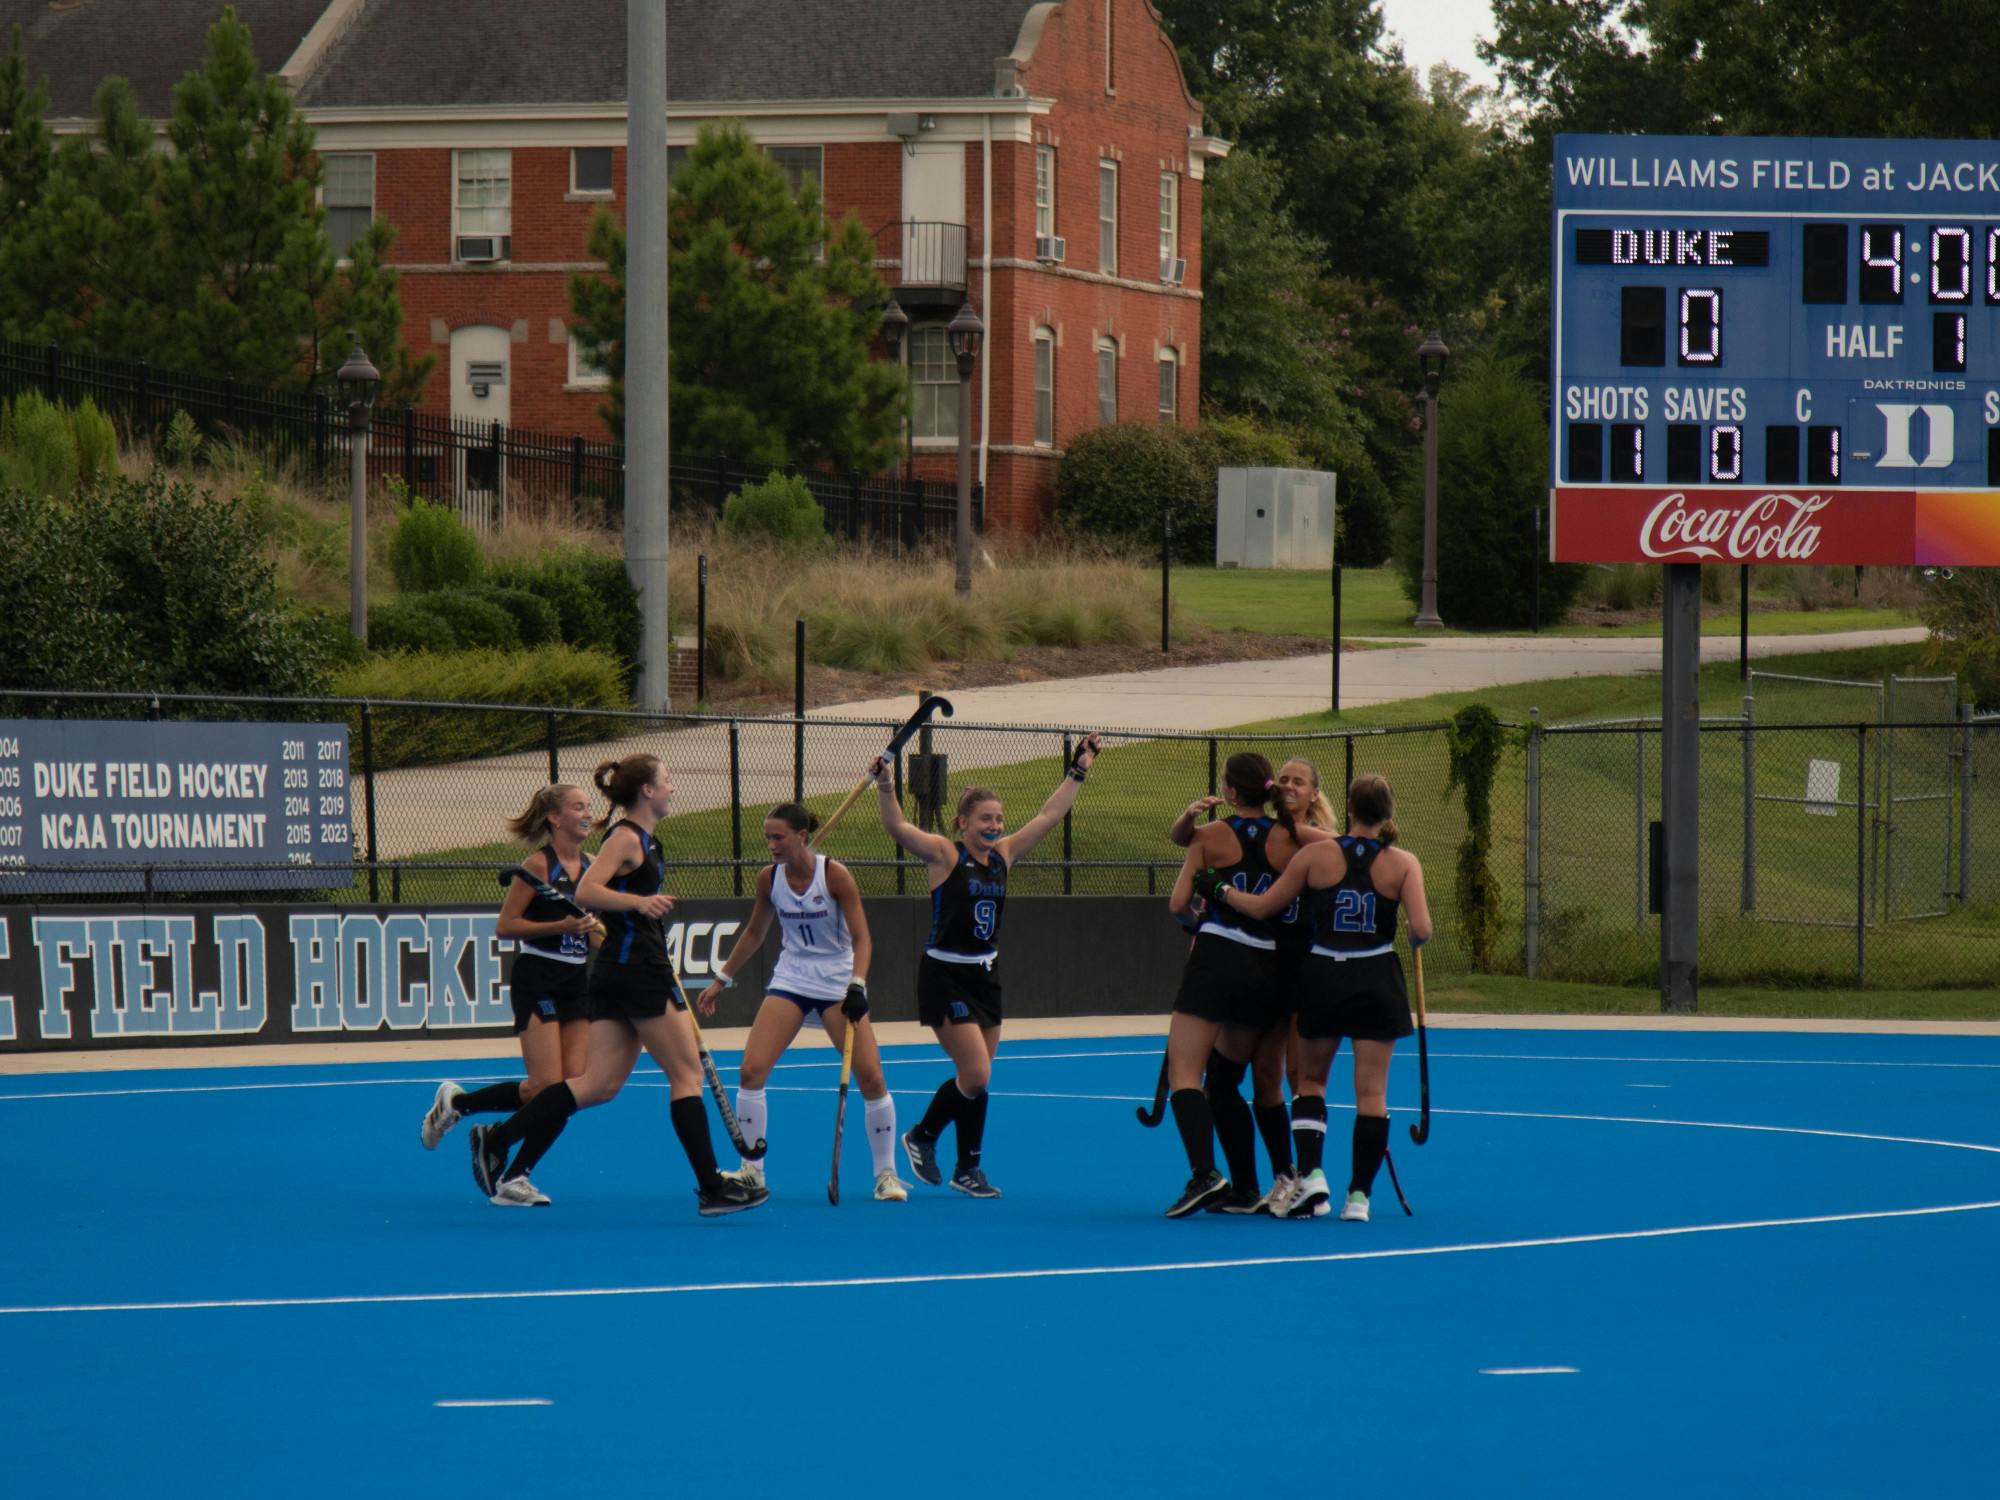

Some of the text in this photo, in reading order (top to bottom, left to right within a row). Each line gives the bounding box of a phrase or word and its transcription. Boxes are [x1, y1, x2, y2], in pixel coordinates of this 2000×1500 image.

[1567, 157, 2000, 192] WILLIAMS FIELD at JACK
[1612, 229, 1735, 265] DUKE
[1681, 289, 1719, 361] 0
[1826, 325, 1903, 358] HALF
[1956, 316, 1965, 365] 1
[1864, 380, 1966, 391] DAKTRONICS
[1567, 386, 1812, 422] SHOTS SAVES C
[1633, 427, 1643, 477] 1
[1712, 426, 1741, 480] 0
[1830, 429, 1840, 478] 1
[1639, 493, 1834, 560] Coca-Cola
[282, 741, 305, 761] 2011
[318, 741, 342, 761] 2017
[34, 762, 268, 798] DUKE FIELD HOCKEY
[283, 768, 308, 789] 2013
[318, 768, 344, 788] 2018
[285, 796, 310, 817] 2014
[319, 796, 344, 816] 2019
[41, 814, 266, 850] NCAA TOURNAMENT
[286, 825, 311, 845] 2015
[320, 824, 348, 843] 2023
[974, 900, 997, 941] 9
[1333, 889, 1376, 934] 21
[666, 921, 741, 975] ACC
[799, 925, 815, 947] 11
[32, 916, 267, 1039] FIELD
[289, 914, 515, 1032] HOCKE
